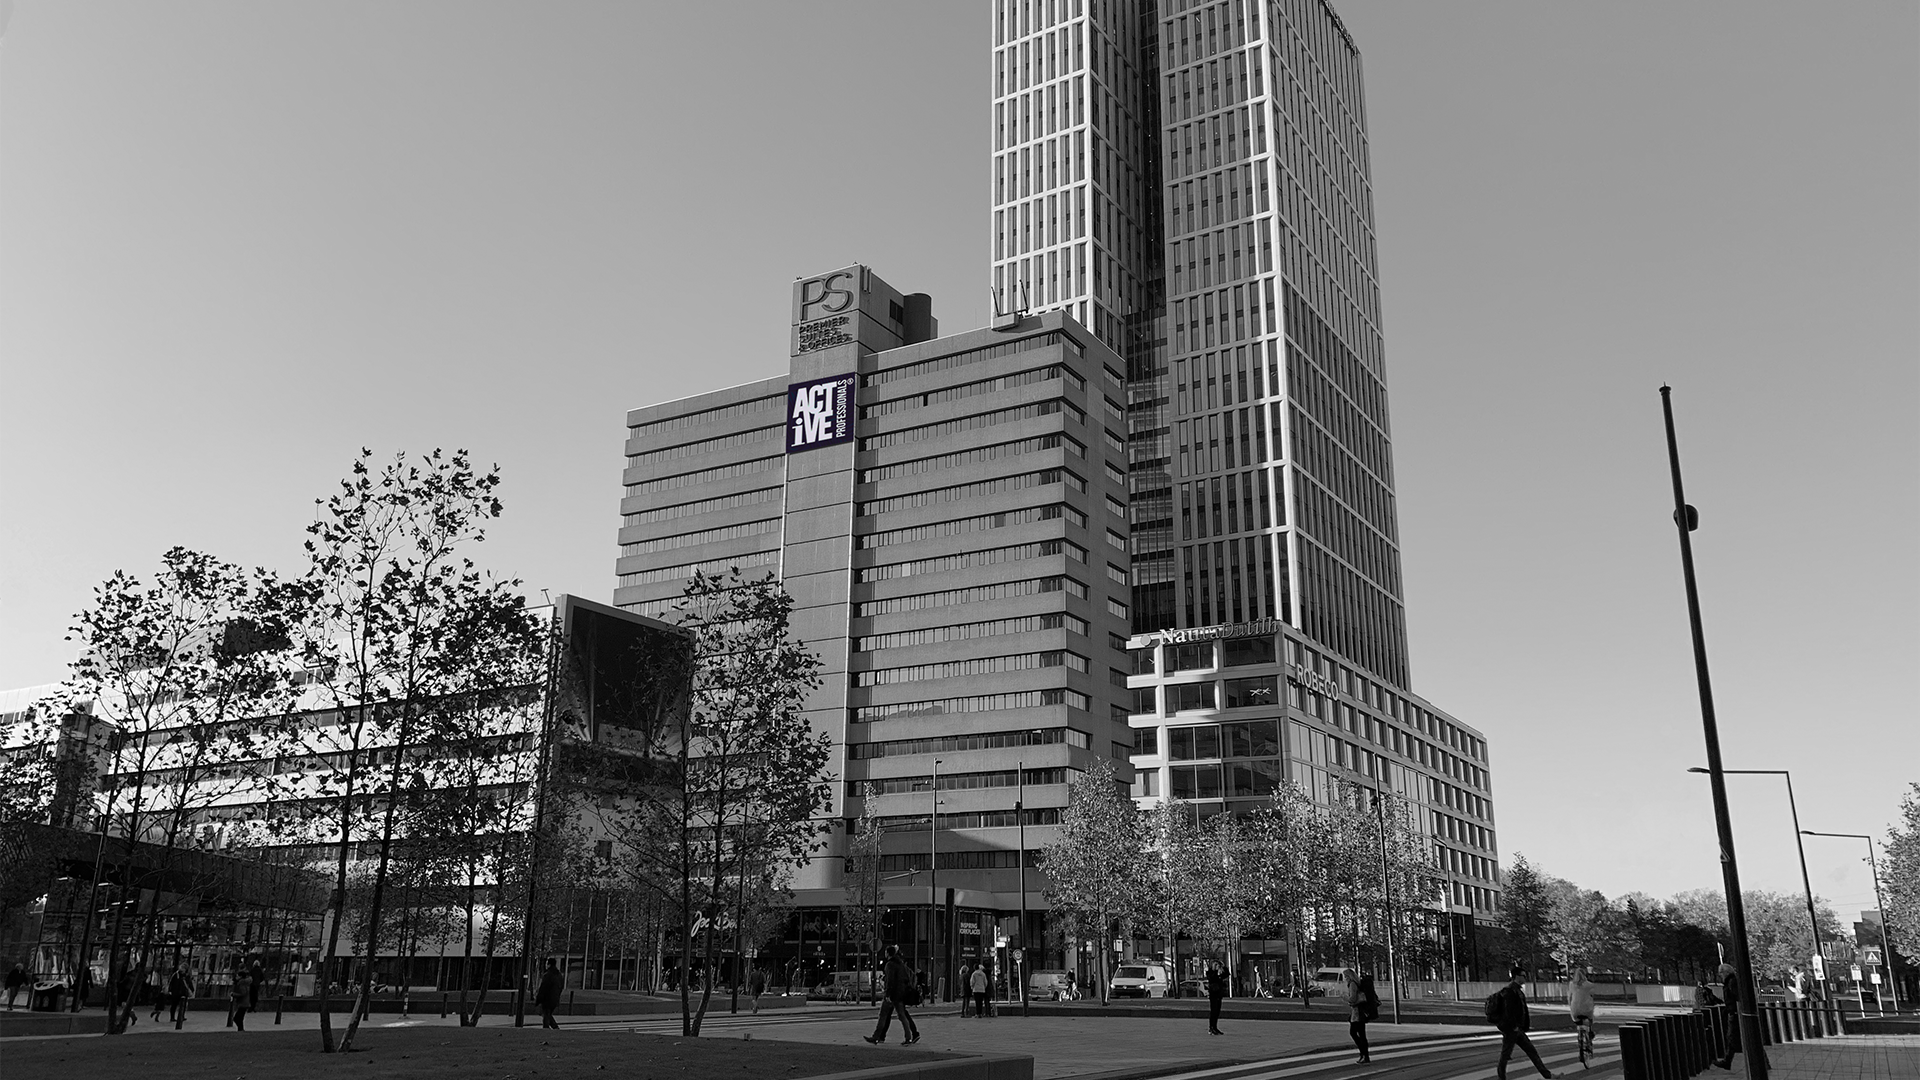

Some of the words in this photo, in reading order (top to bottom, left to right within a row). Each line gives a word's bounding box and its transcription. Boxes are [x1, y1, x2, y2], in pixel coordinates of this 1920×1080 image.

[800, 272, 854, 321] PS
[792, 381, 838, 419] ACT
[1159, 616, 1280, 645] NautaDutilh
[1297, 663, 1339, 702] ROBECO
